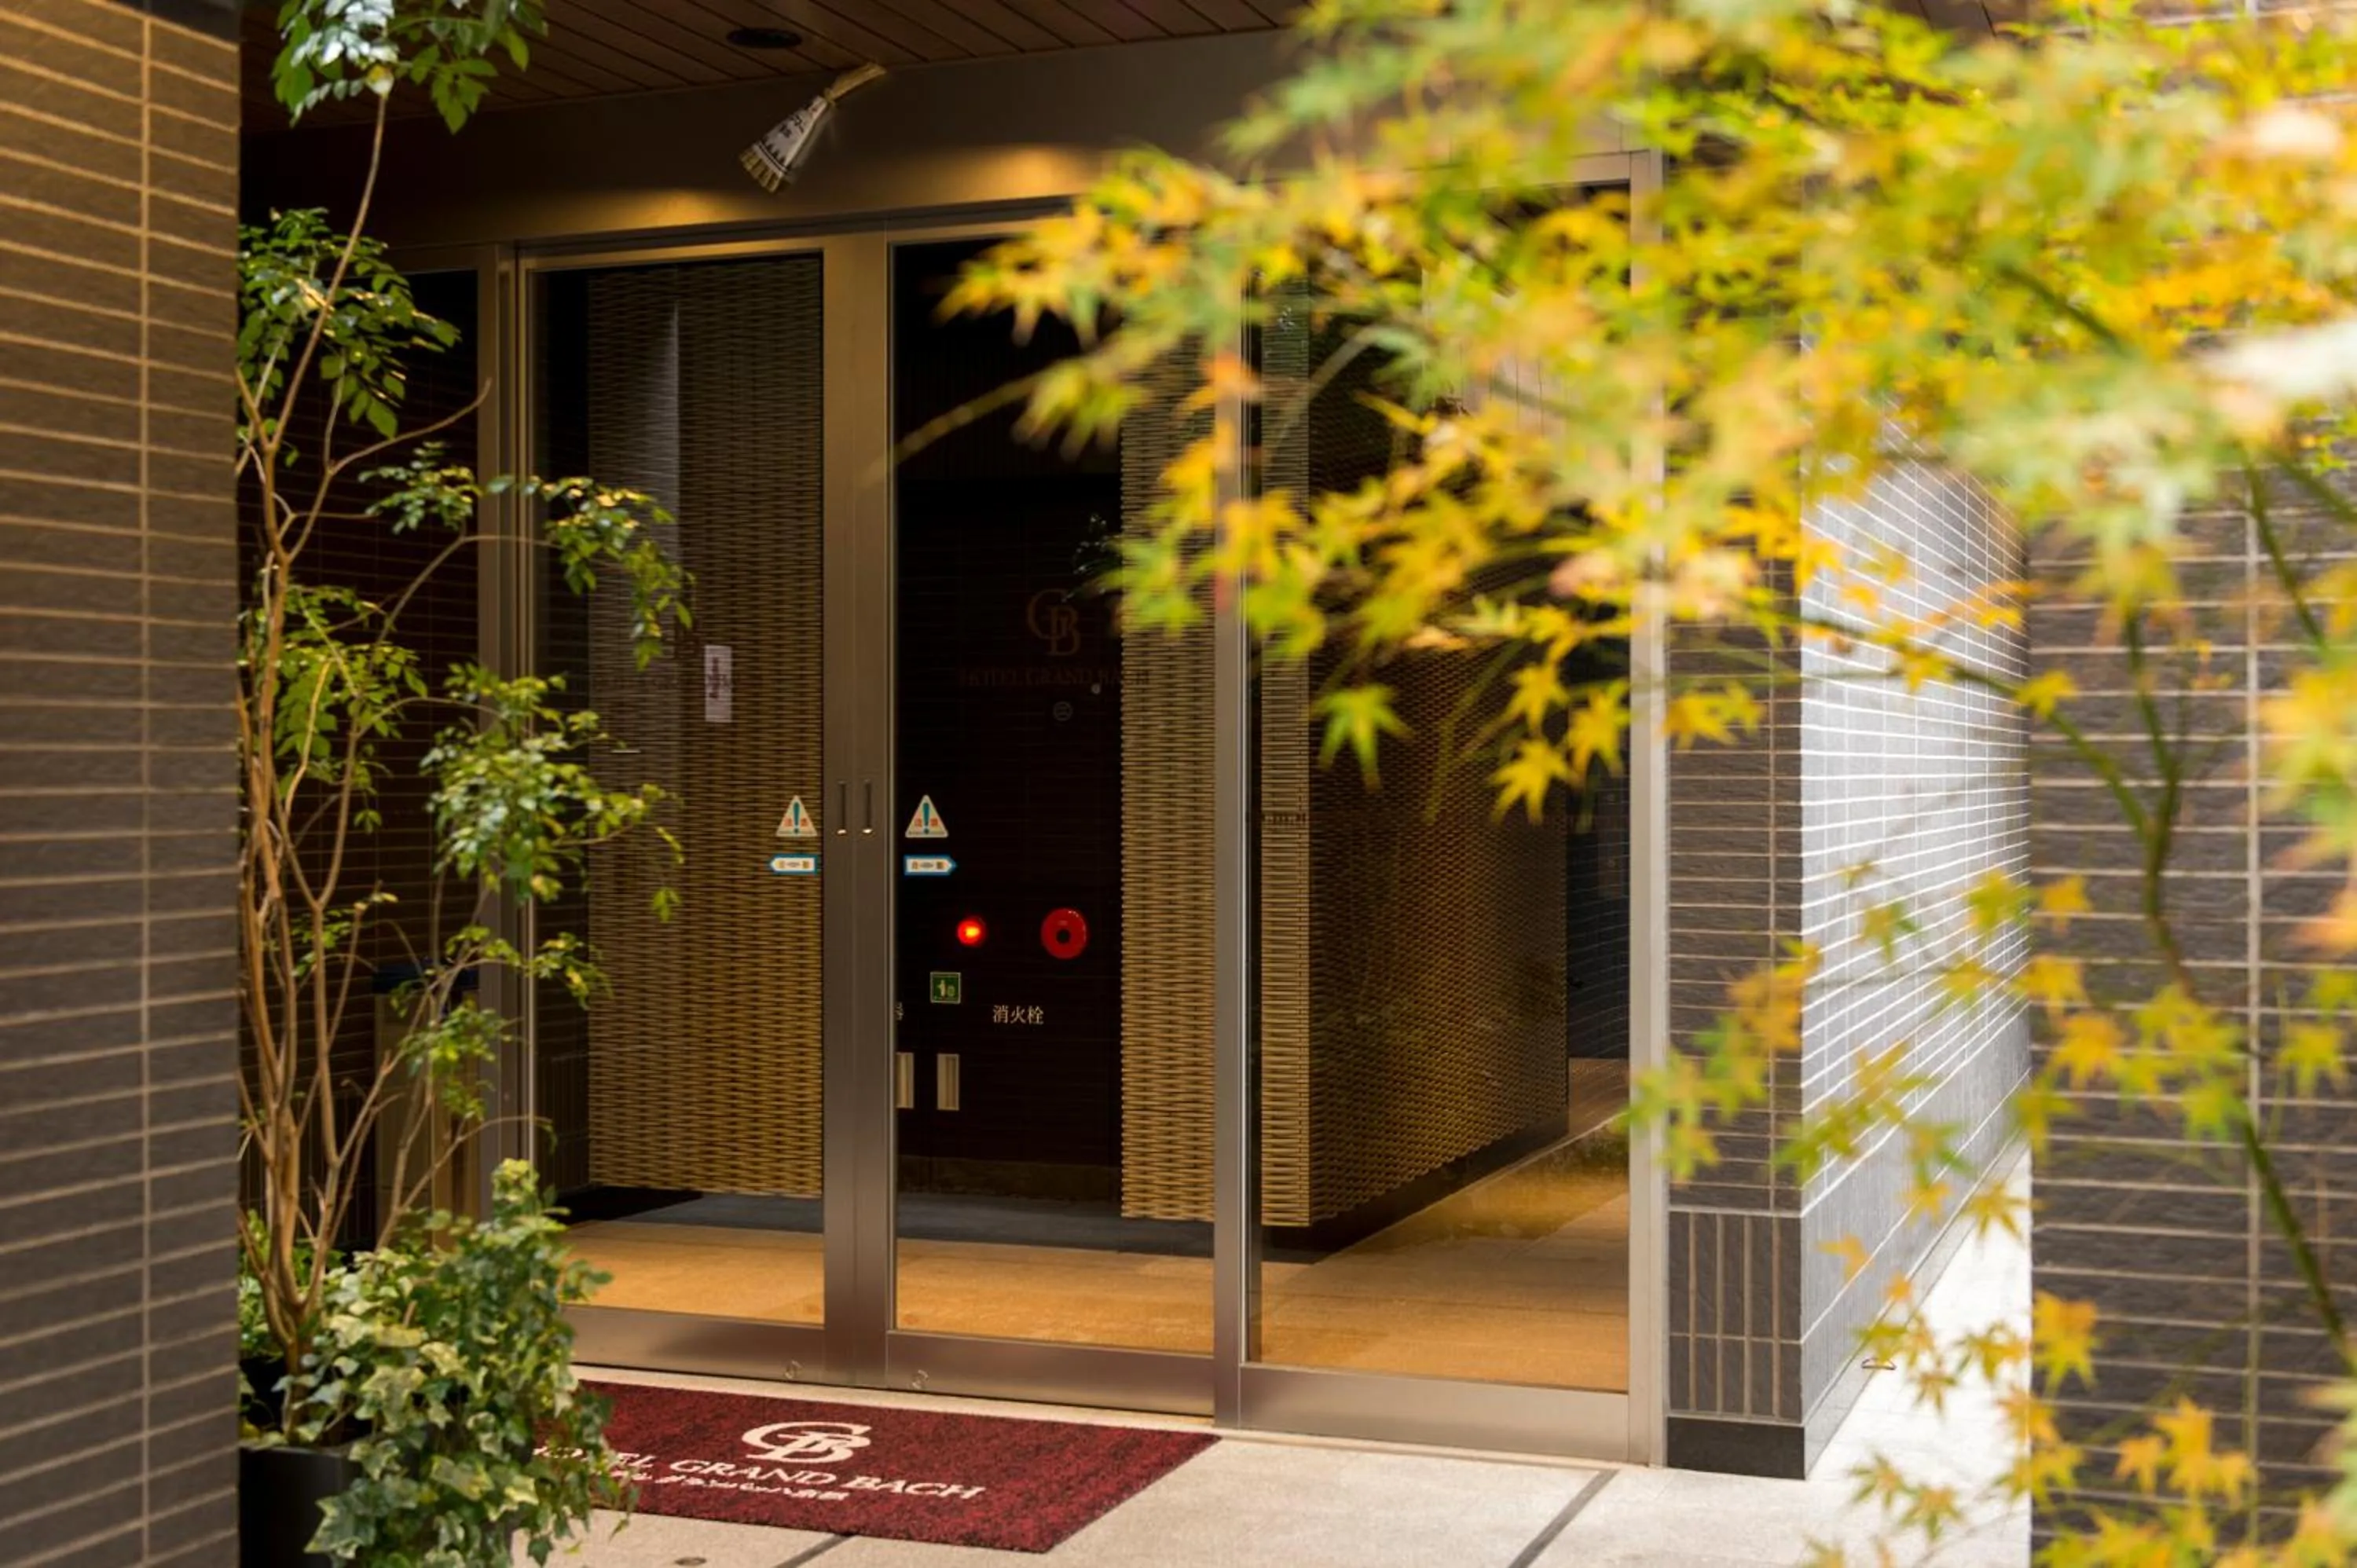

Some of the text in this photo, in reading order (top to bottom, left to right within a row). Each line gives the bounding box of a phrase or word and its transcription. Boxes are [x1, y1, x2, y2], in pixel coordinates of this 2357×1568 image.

[993, 1005, 1043, 1024] 消火栓
[669, 1459, 837, 1485] GRAND
[841, 1475, 986, 1500] BACH
